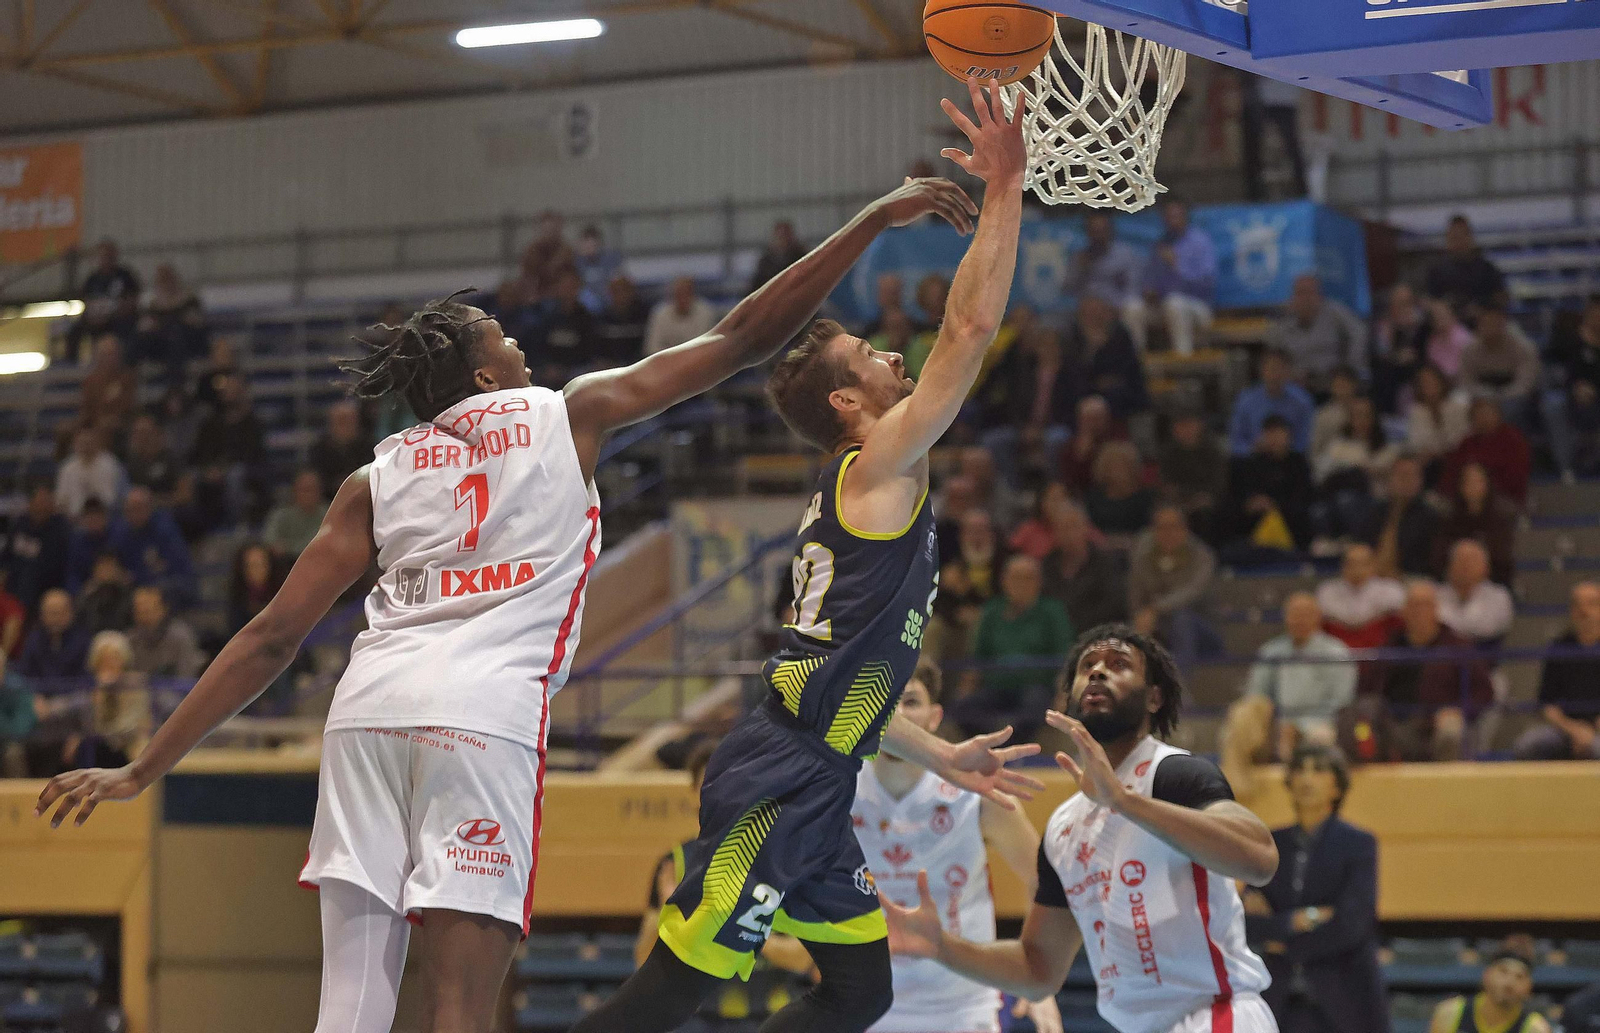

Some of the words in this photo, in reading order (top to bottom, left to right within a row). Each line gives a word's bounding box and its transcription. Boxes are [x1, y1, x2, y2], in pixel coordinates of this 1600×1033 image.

[413, 423, 531, 472] BERTHOLD
[441, 562, 536, 597] IXMA
[455, 861, 504, 877] Lemauto
